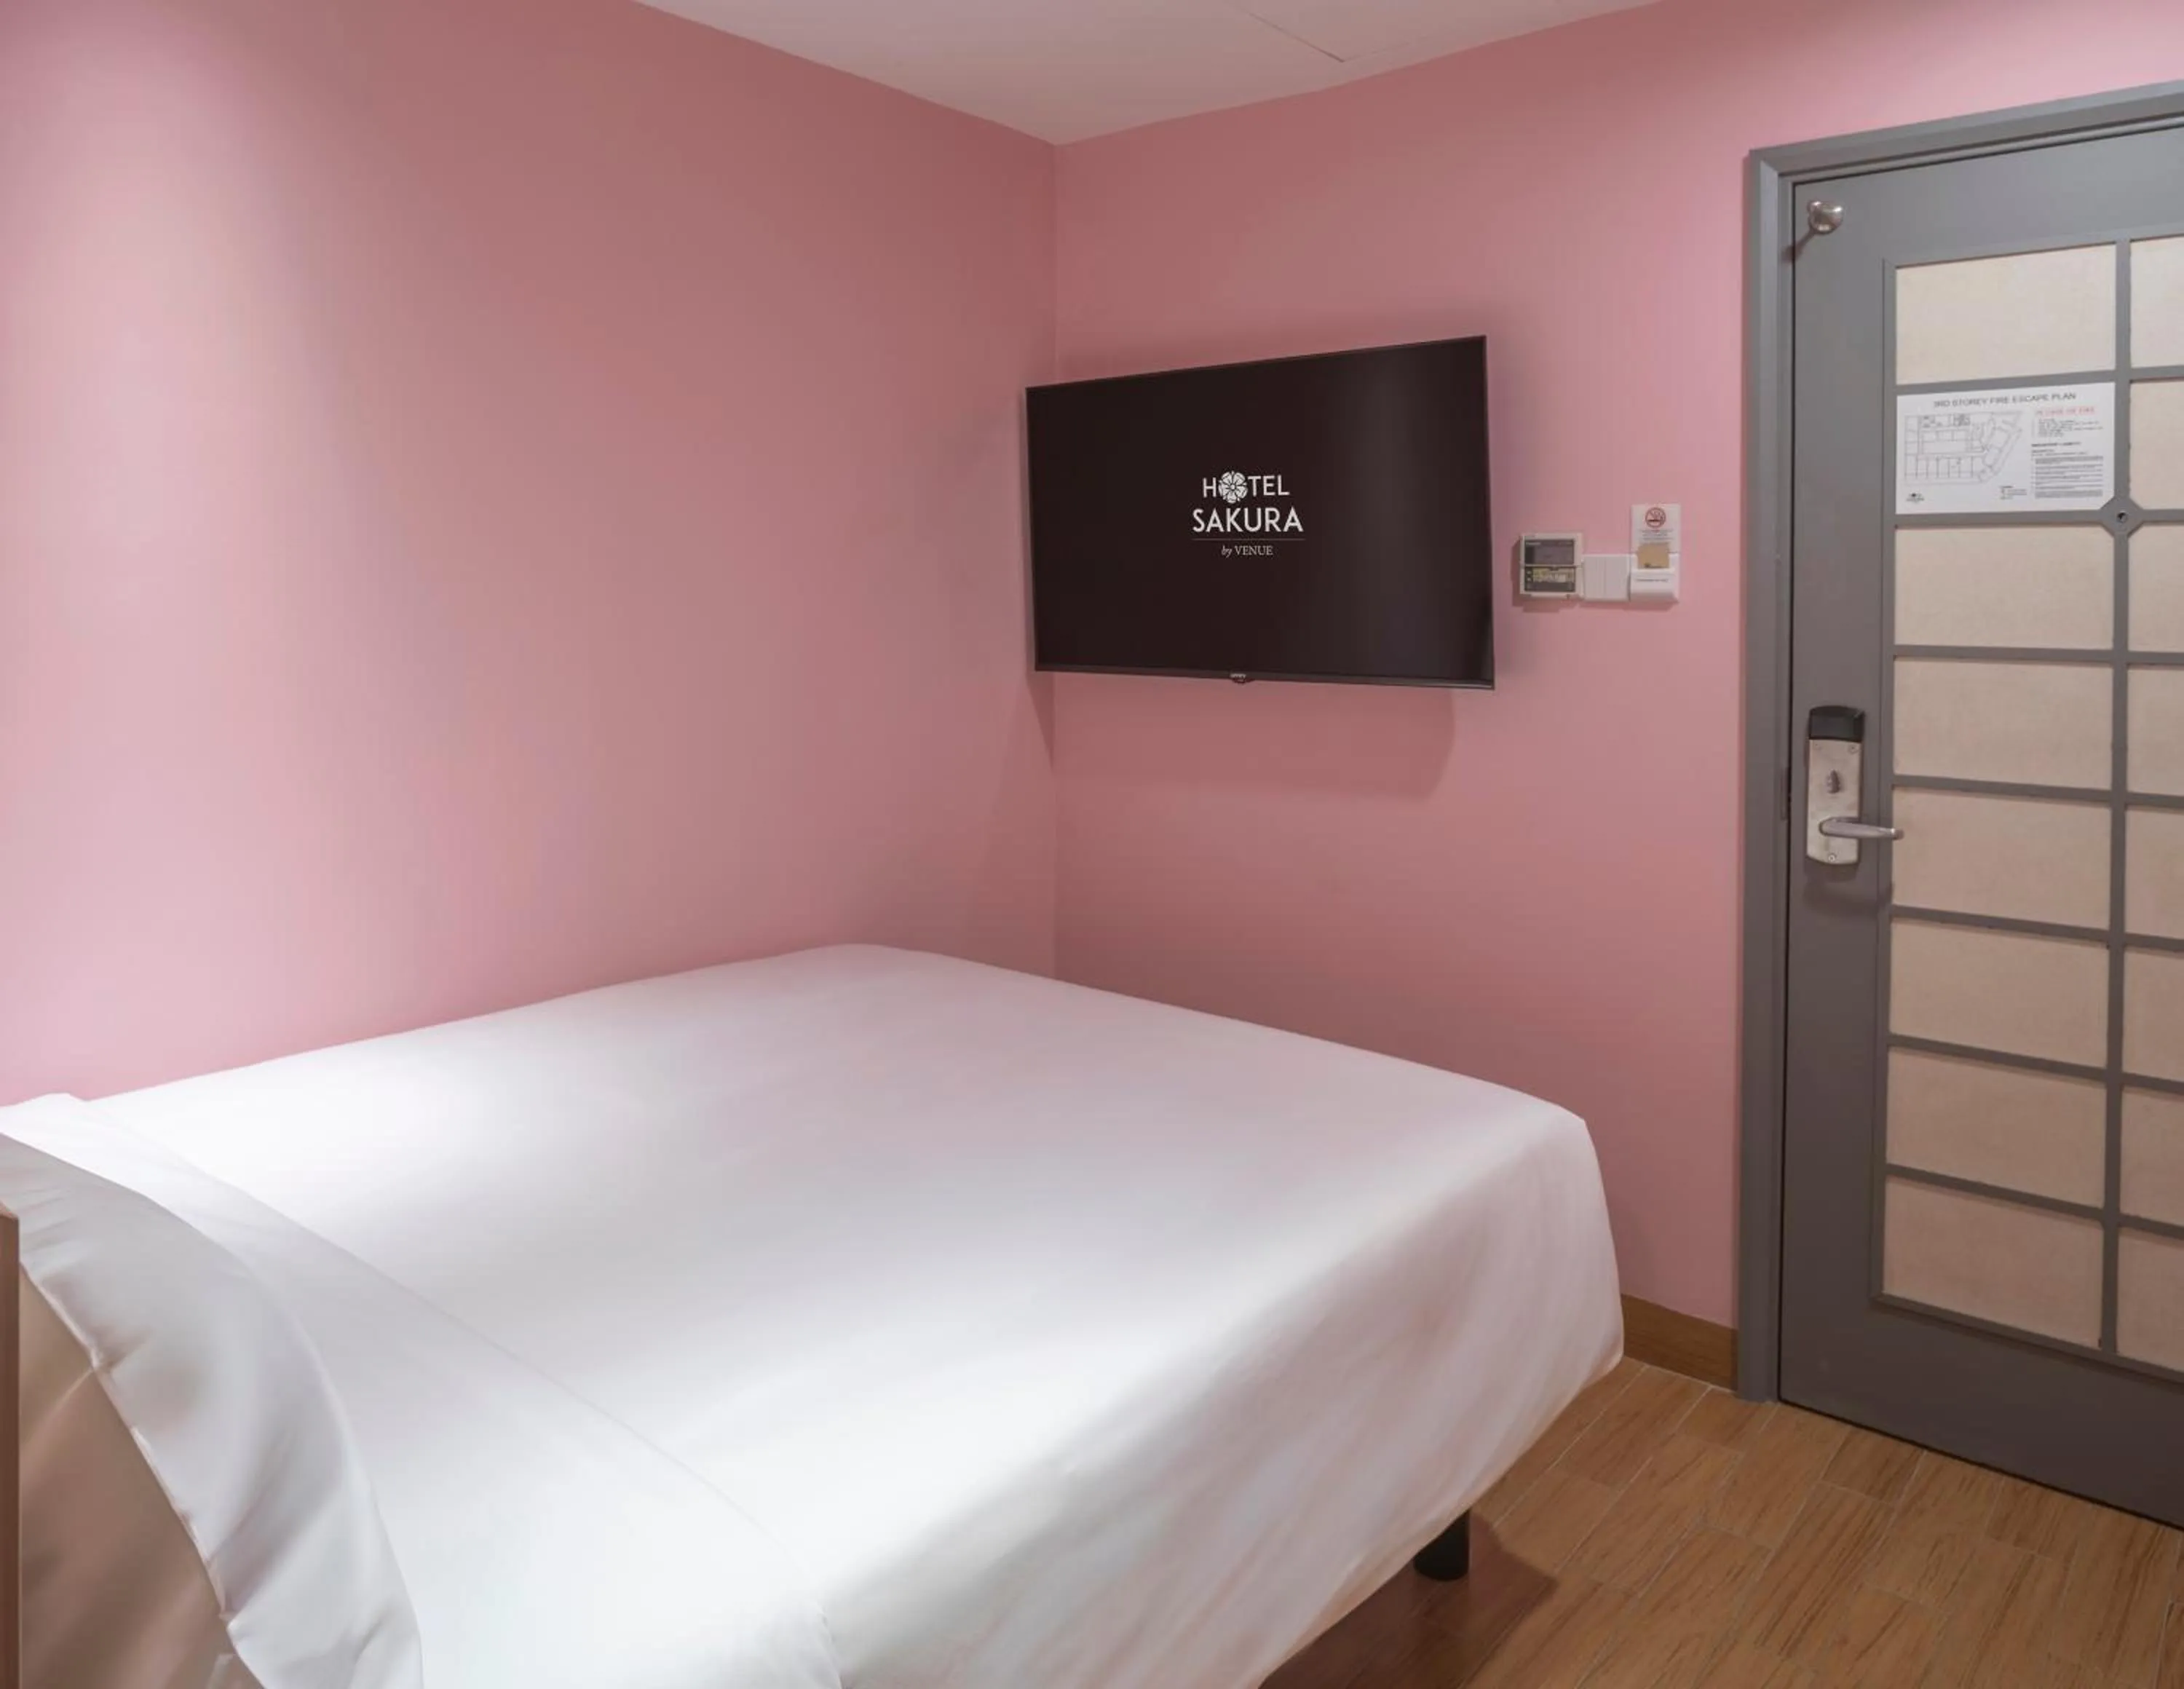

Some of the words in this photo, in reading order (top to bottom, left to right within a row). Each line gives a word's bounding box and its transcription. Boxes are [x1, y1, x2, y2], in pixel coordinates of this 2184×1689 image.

[2052, 392, 2076, 401] PLAN
[1192, 507, 1304, 532] SAKURA
[1221, 545, 1233, 558] by
[1235, 545, 1273, 555] VENUE
